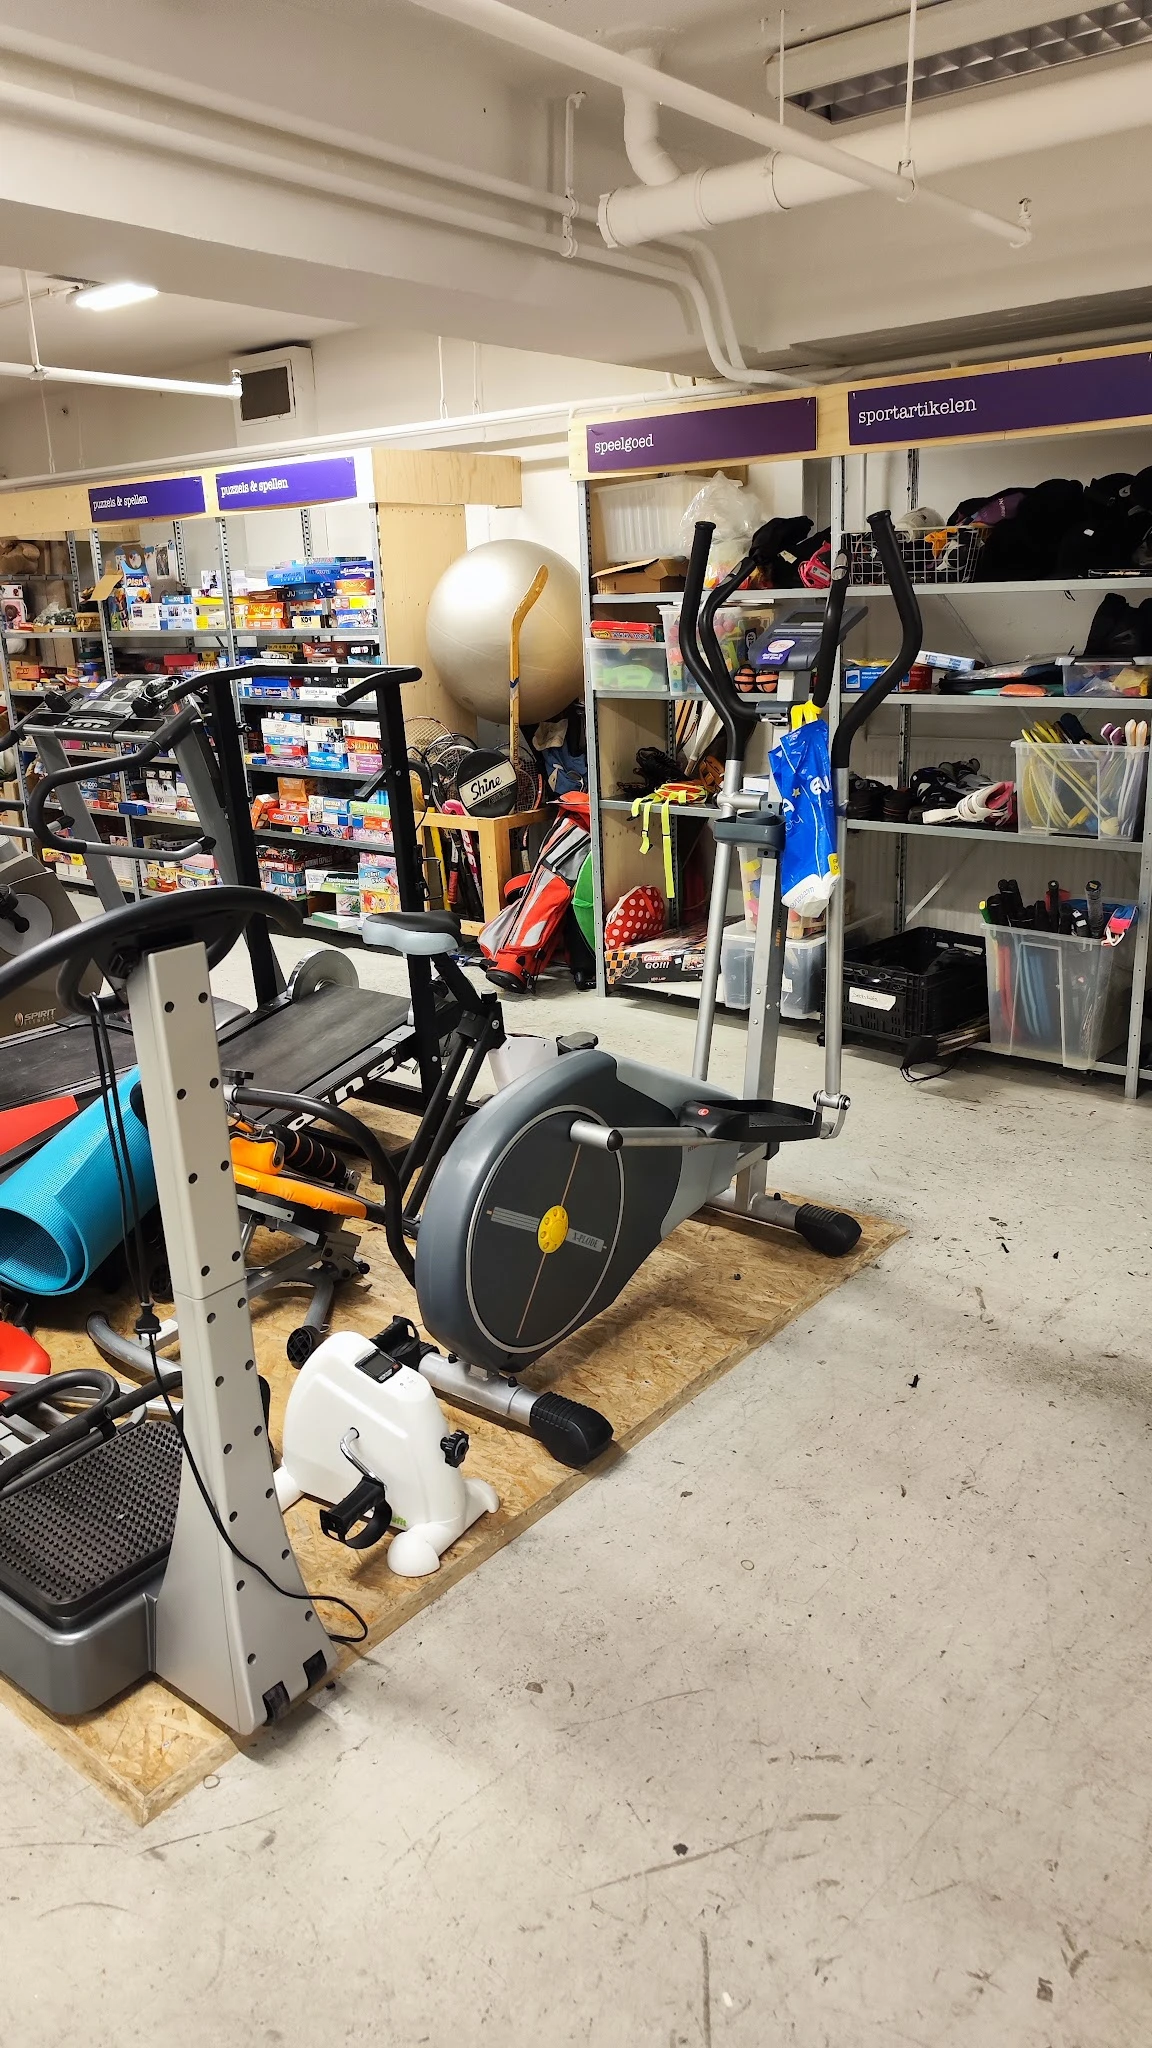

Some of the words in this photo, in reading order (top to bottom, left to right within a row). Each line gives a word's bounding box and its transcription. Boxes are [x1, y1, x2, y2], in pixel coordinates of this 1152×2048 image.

[858, 398, 977, 426] sportartikelen
[594, 433, 654, 455] speelgoed
[220, 482, 249, 498] puzzels
[250, 480, 258, 492] &
[258, 478, 289, 493] spellen
[92, 497, 116, 511] puzzels
[116, 495, 123, 506] &
[123, 494, 148, 508] spellen
[470, 776, 502, 801] Shine
[644, 961, 670, 969] GO!!!
[24, 1007, 57, 1022] SPIRIT
[573, 1231, 598, 1248] X-PLODE
